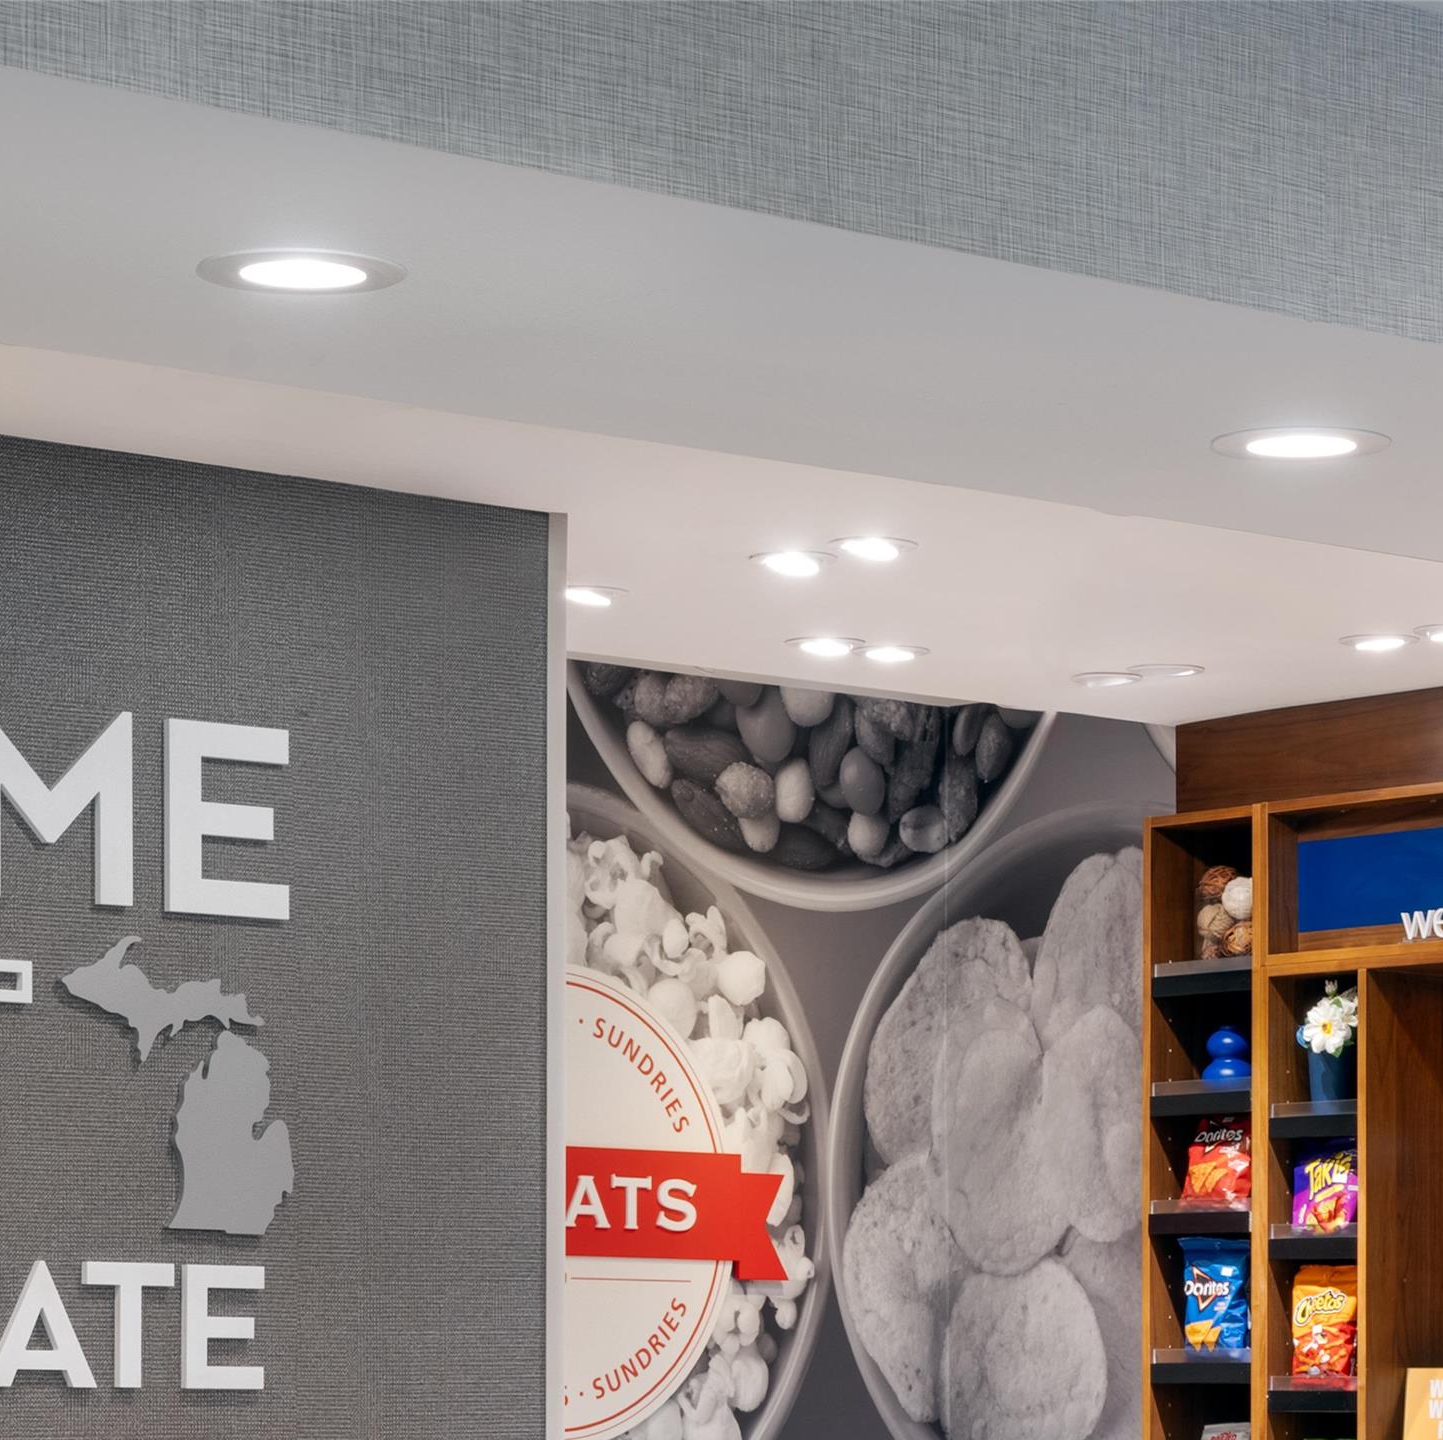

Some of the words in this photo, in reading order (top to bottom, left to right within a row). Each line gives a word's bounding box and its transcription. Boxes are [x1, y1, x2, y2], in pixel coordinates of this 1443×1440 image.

[592, 1017, 690, 1134] SUNDRIES
[565, 1172, 698, 1233] ATS
[1183, 1279, 1230, 1297] Doritos
[592, 1297, 687, 1399] SUNDRIES
